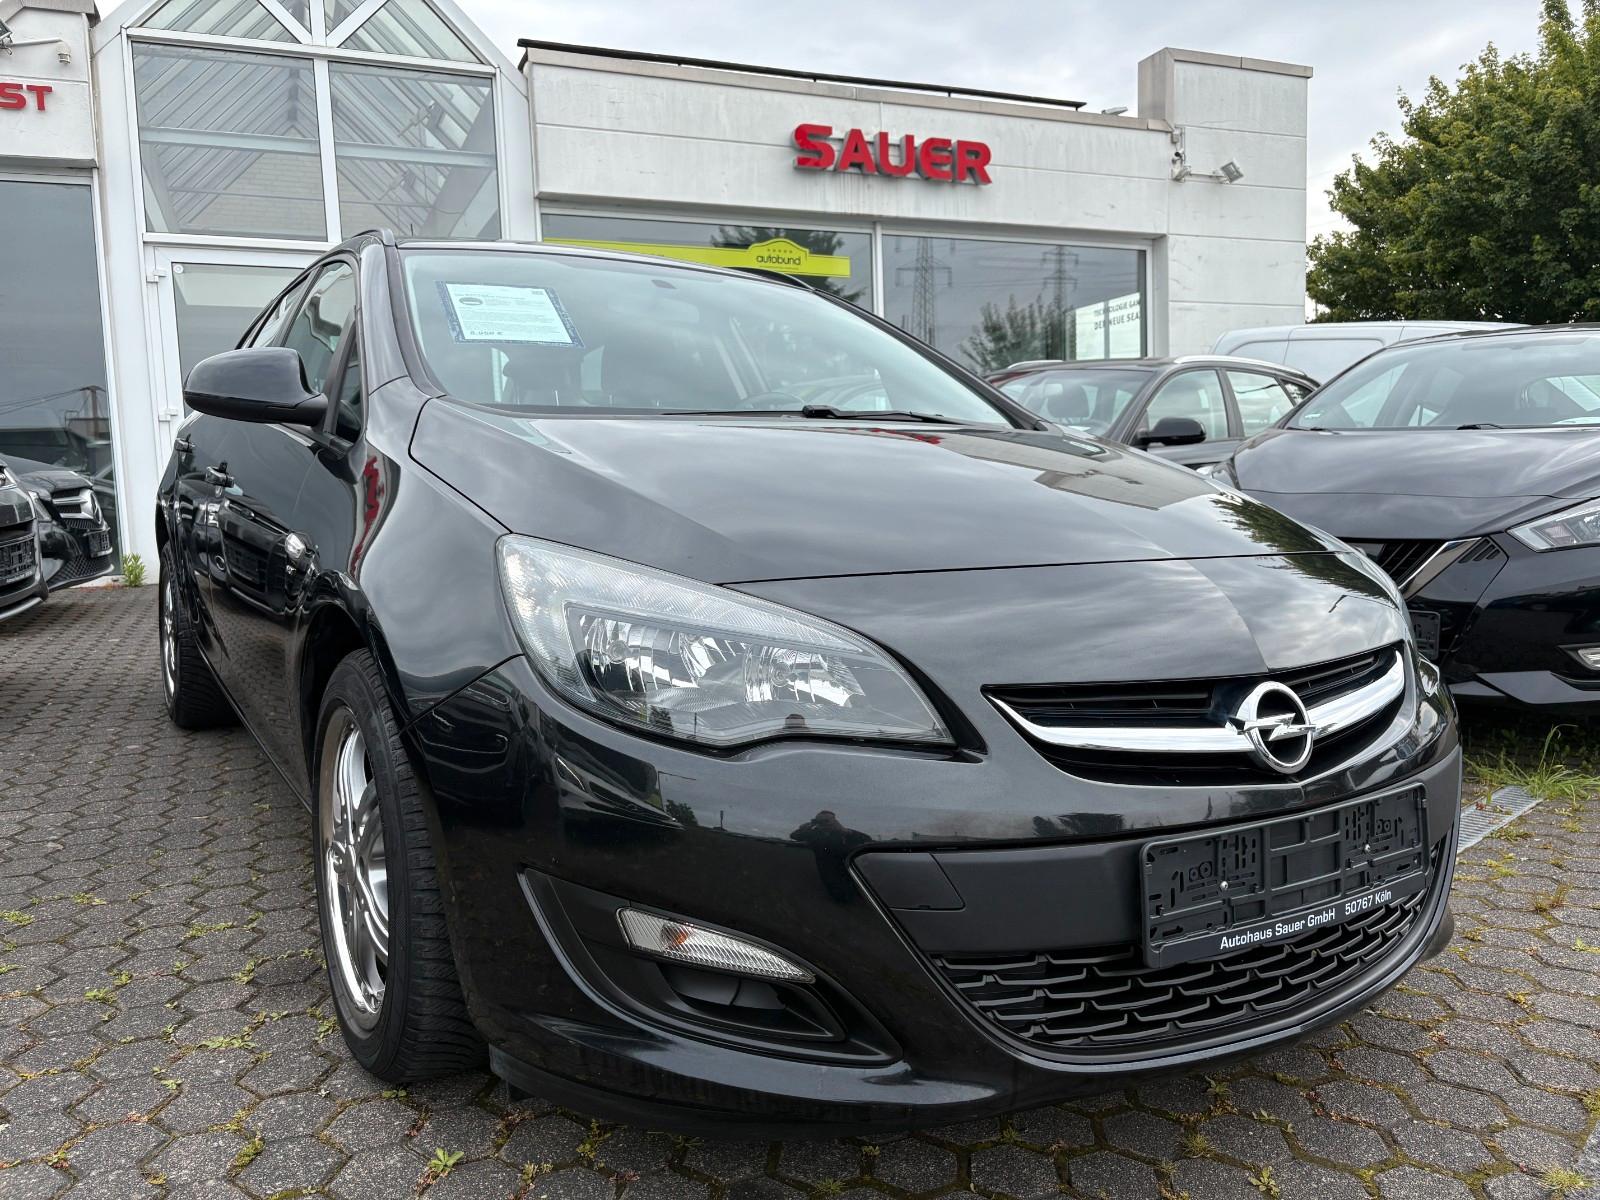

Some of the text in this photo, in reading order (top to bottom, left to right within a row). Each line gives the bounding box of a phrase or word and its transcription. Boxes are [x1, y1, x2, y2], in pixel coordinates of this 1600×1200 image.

[0, 83, 52, 111] ST
[793, 123, 992, 184] SAUER
[756, 254, 801, 266] autobund
[1220, 889, 1392, 950] Autohaus Sauer GmbH 50767 Köln
